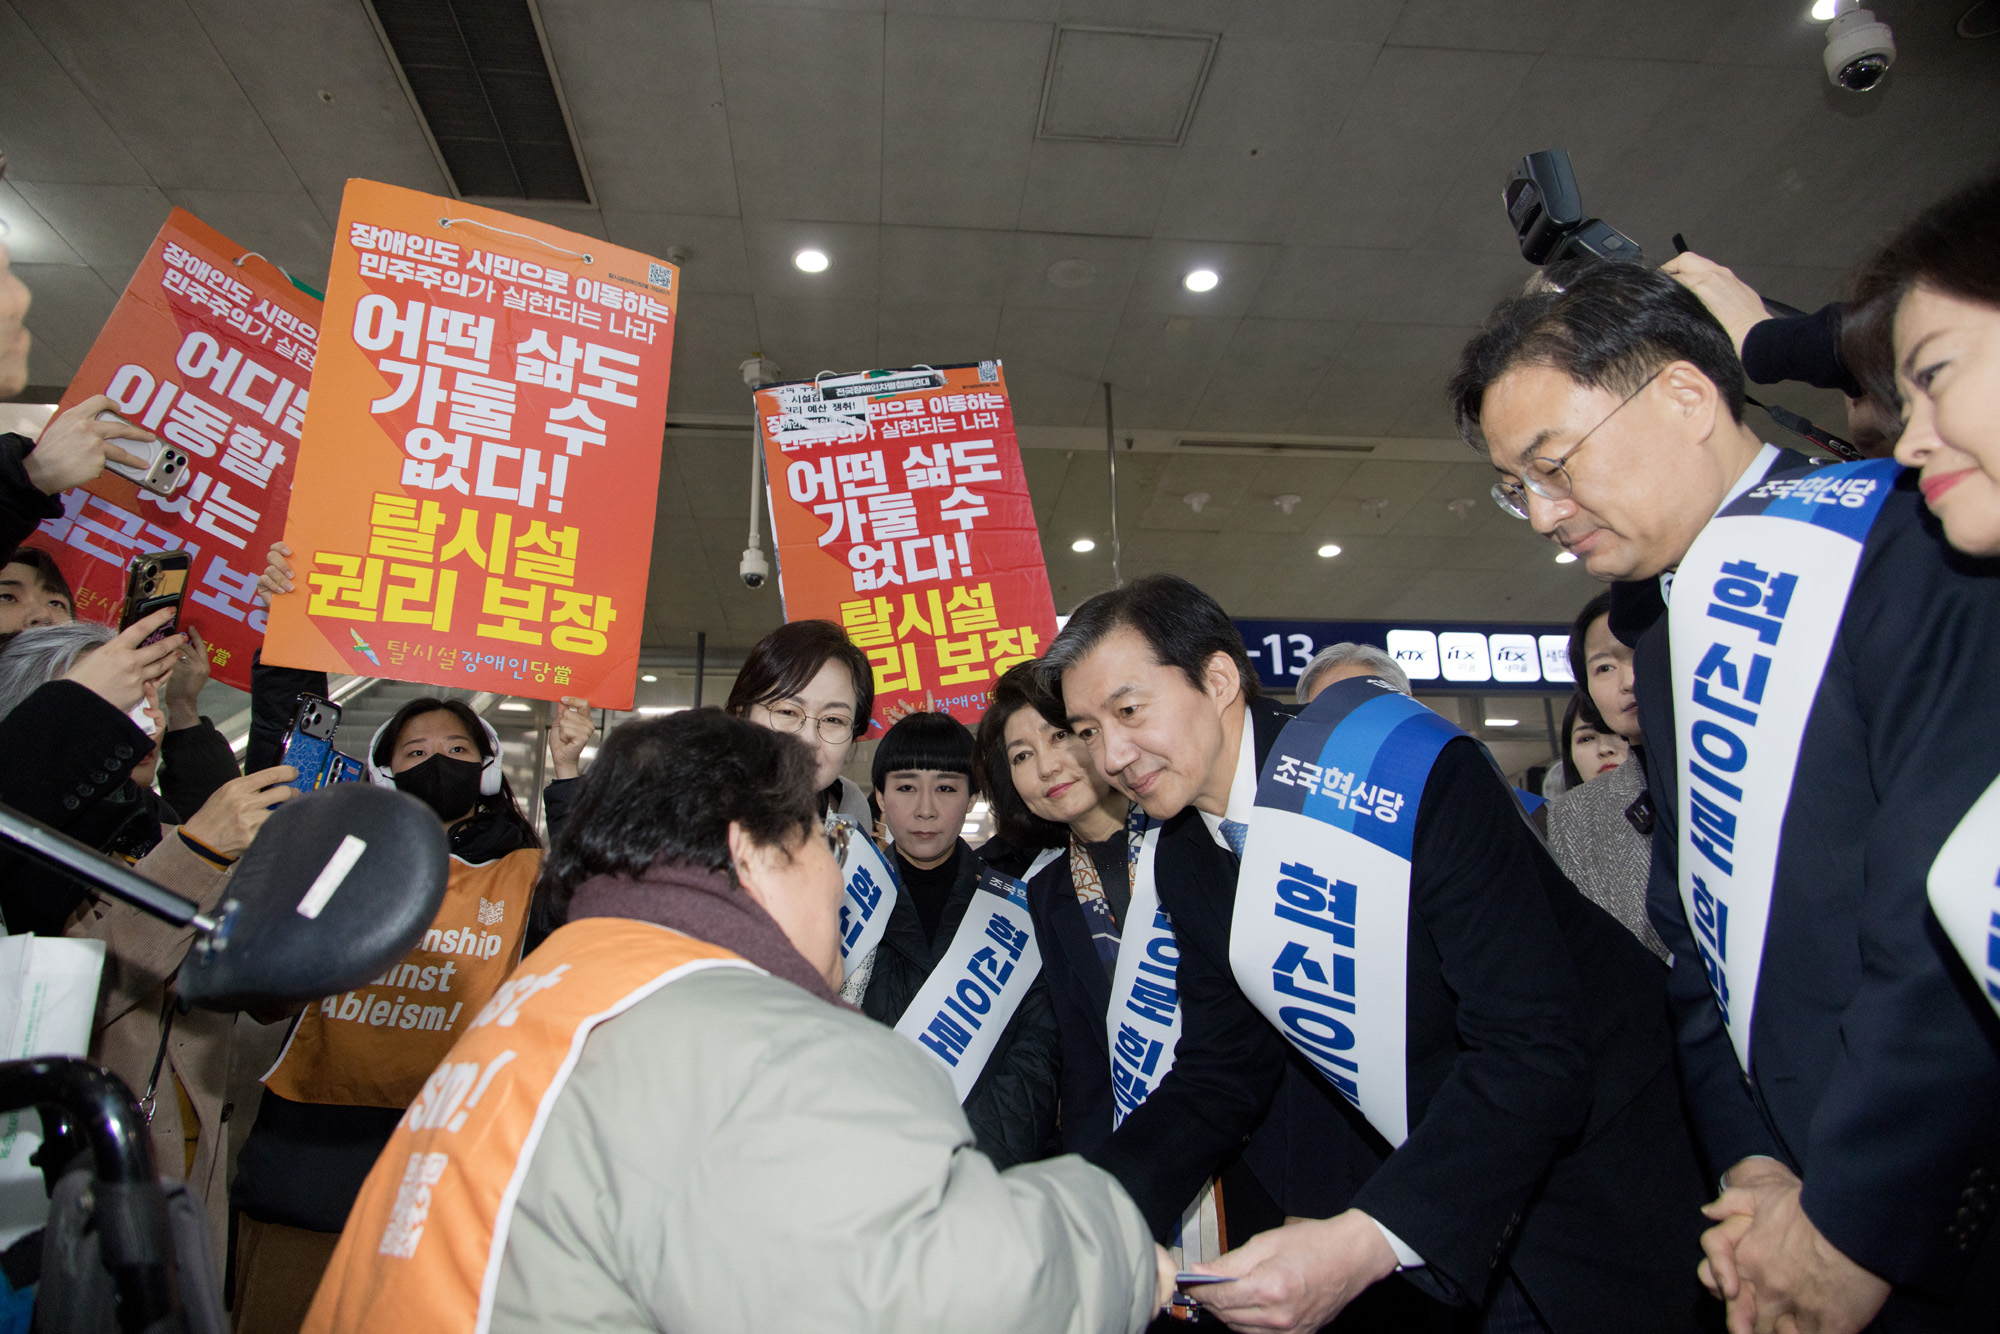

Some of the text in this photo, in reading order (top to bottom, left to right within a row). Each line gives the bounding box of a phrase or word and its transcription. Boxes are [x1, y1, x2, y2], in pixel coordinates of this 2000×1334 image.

[161, 267, 273, 344] 민주주의가
[162, 241, 318, 350] 장애인도 시민으
[350, 222, 669, 324] 장애인도 시민으로 이동하는
[359, 253, 657, 345] 민주주의가 실현되는 나라
[352, 293, 641, 409] 어떤 삶도
[105, 364, 286, 489] 이동할
[370, 358, 607, 457] 가둘 수
[807, 403, 827, 413] 예산
[832, 401, 856, 412] 쟁취!
[869, 392, 1005, 421] 민으로 이동하는
[880, 415, 957, 441] 실현되는
[961, 411, 1000, 430] 나라
[400, 427, 569, 514] 없다!
[786, 439, 1003, 503] 어떤 삶도
[1748, 476, 1877, 508] 조국혁신당
[369, 492, 580, 587] 탈시설
[814, 486, 989, 548] 가둘 수
[848, 532, 974, 592] 없다!
[307, 551, 459, 633] 권리
[476, 576, 617, 656] 보장
[840, 582, 1000, 648] 탈시설
[866, 642, 922, 696] 리
[1396, 649, 1428, 661] KTX
[1690, 559, 1799, 877] 혁신으로
[1272, 754, 1405, 824] 조국혁신당
[416, 926, 502, 960] nship
[320, 991, 463, 1031] Ableism!
[918, 912, 1030, 1068] 혁신으로
[398, 1048, 519, 1133] sm!
